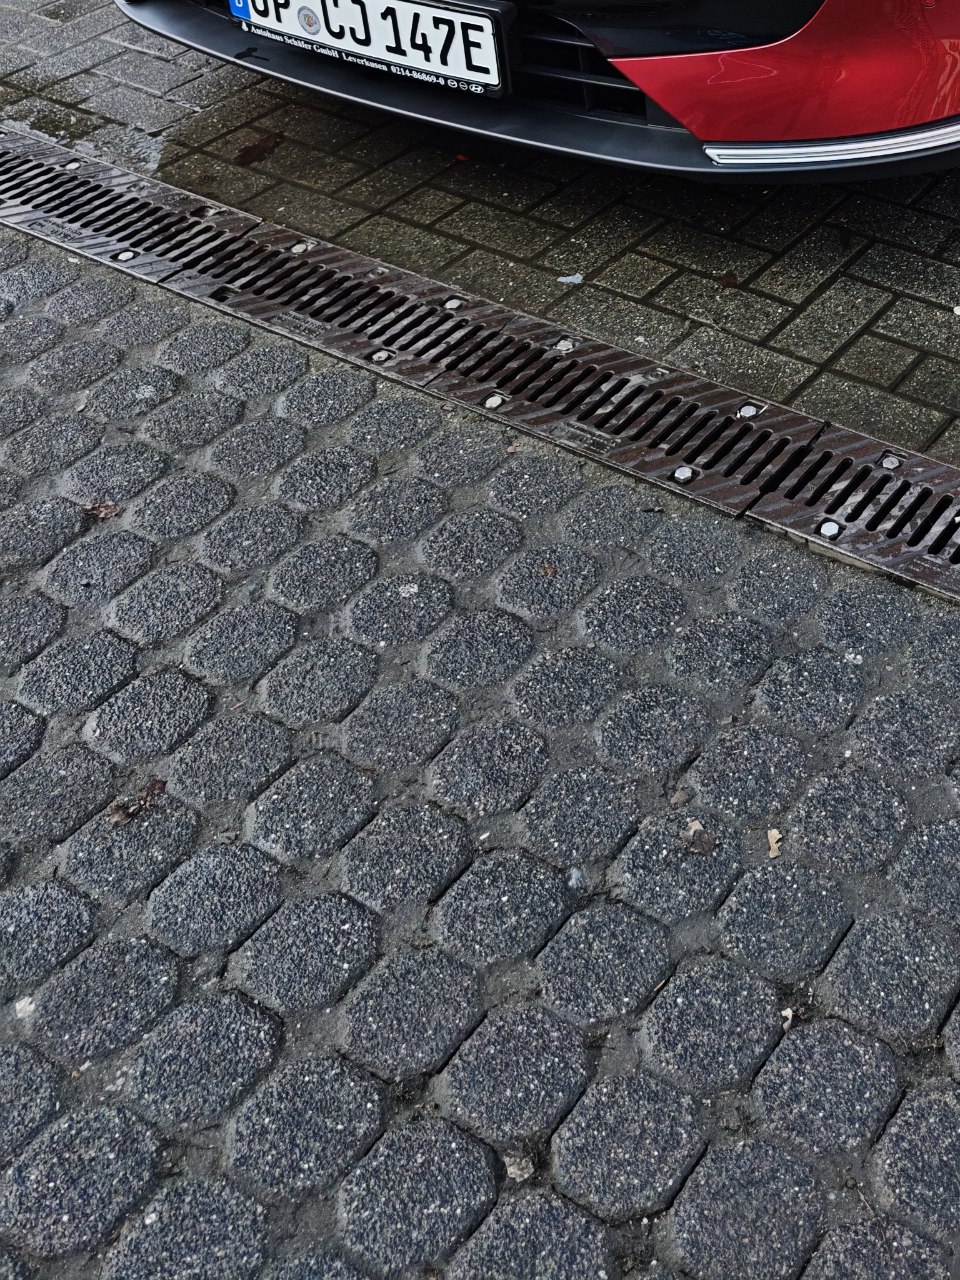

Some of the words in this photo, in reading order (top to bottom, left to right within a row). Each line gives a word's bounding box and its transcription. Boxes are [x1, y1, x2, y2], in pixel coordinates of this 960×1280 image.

[250, 25, 284, 42] Autohaus
[284, 35, 312, 51] Schäfer
[313, 43, 339, 58] GmbH
[342, 52, 388, 72] Leverkusen
